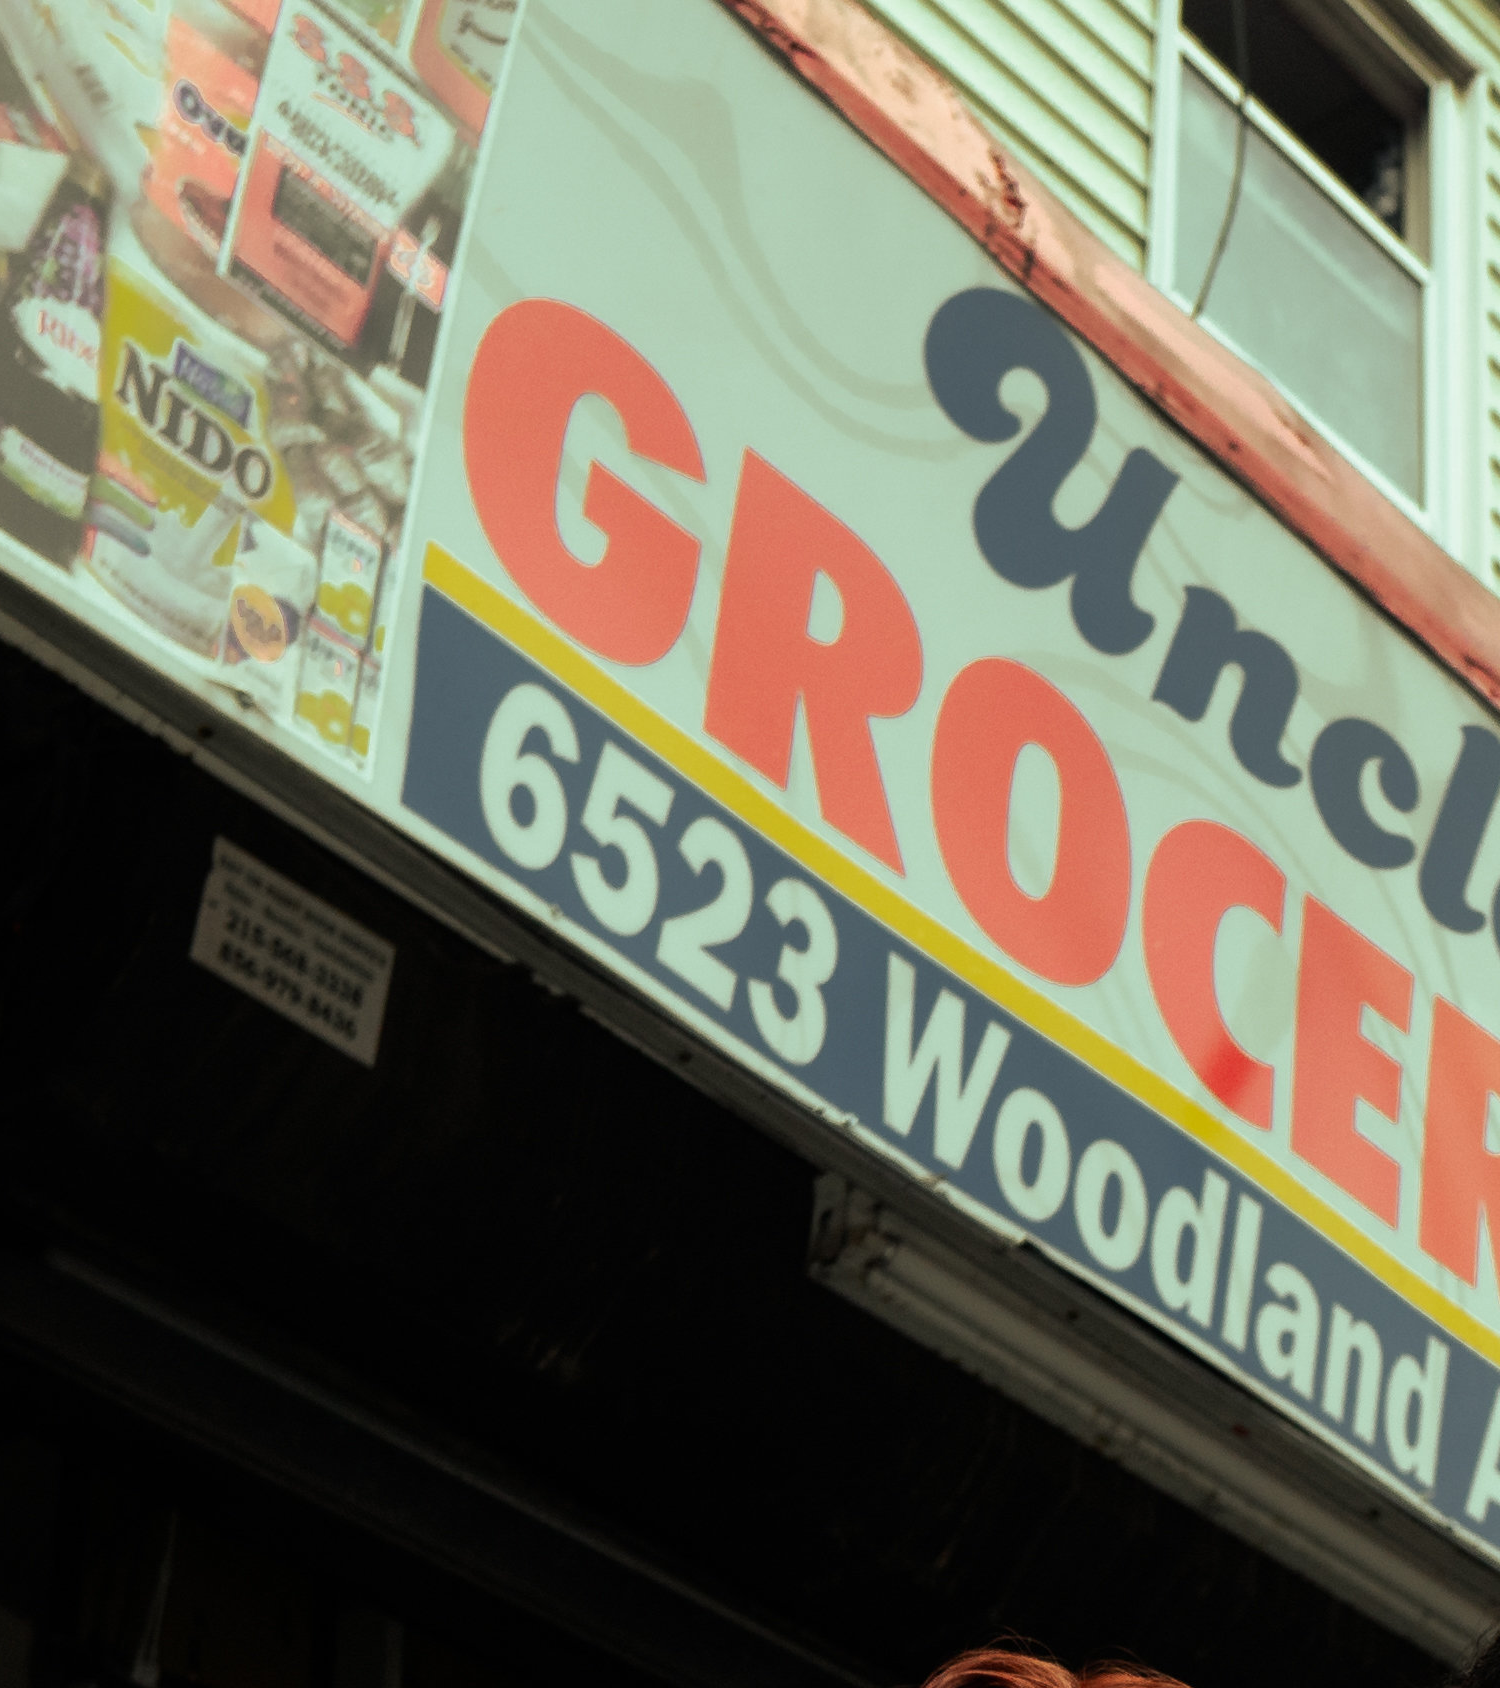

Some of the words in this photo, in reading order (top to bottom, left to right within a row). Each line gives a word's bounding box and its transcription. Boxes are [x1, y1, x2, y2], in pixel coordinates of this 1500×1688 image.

[115, 340, 273, 500] NIDO
[480, 682, 839, 1064] 6523
[883, 952, 1450, 1488] Woodland
